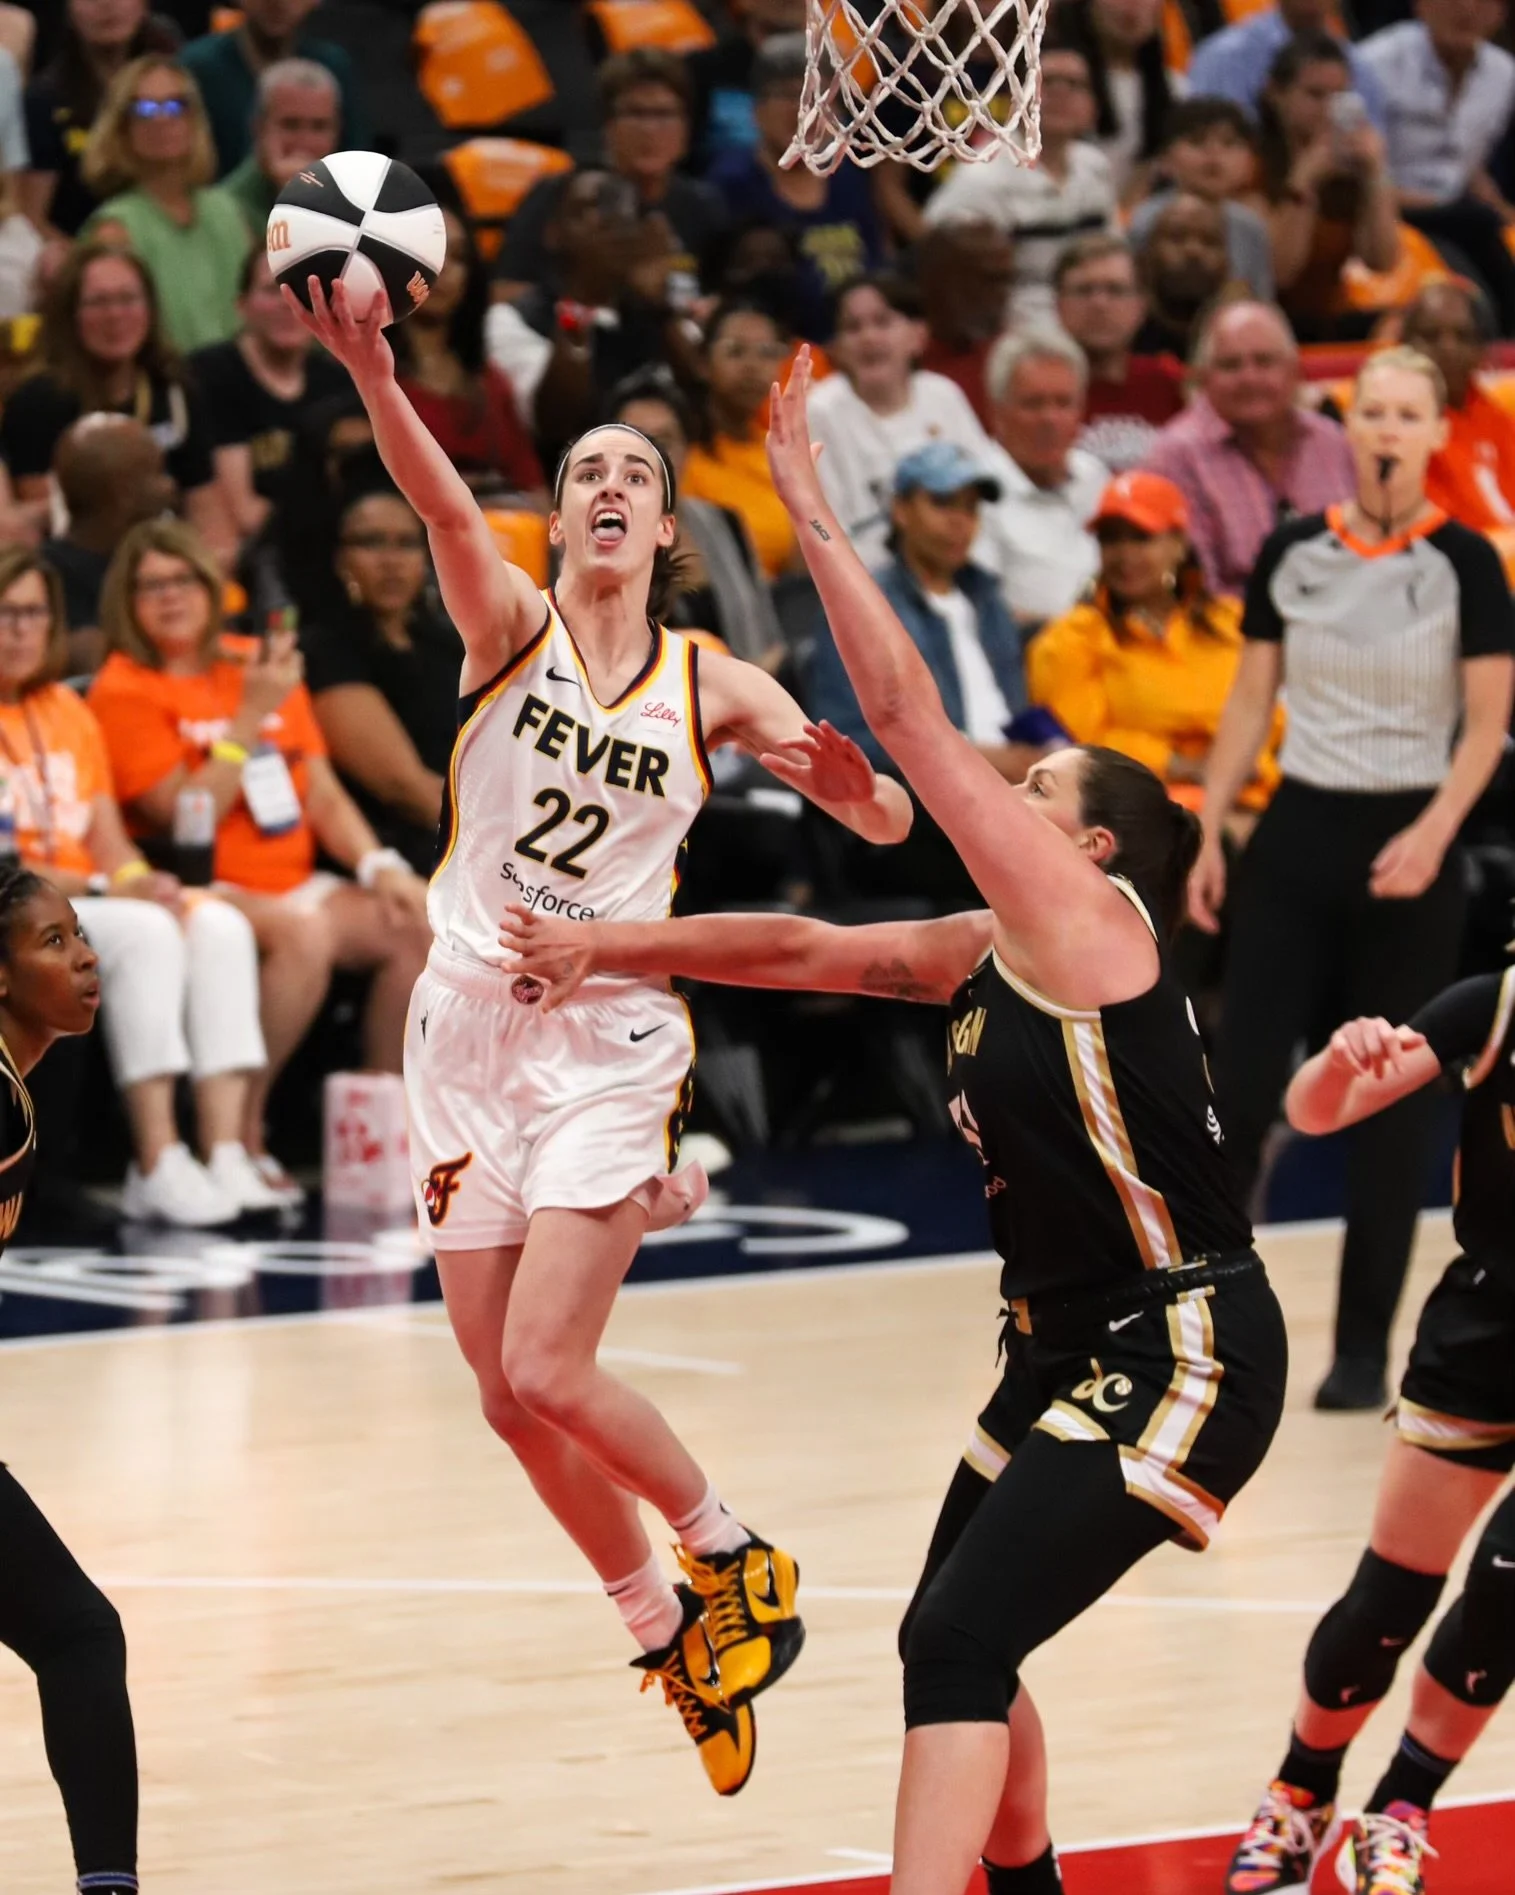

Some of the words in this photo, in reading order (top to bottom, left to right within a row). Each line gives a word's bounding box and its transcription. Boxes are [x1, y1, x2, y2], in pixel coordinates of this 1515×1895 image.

[512, 692, 670, 798] FEVER
[640, 701, 682, 728] Lilly
[514, 787, 610, 879] 22
